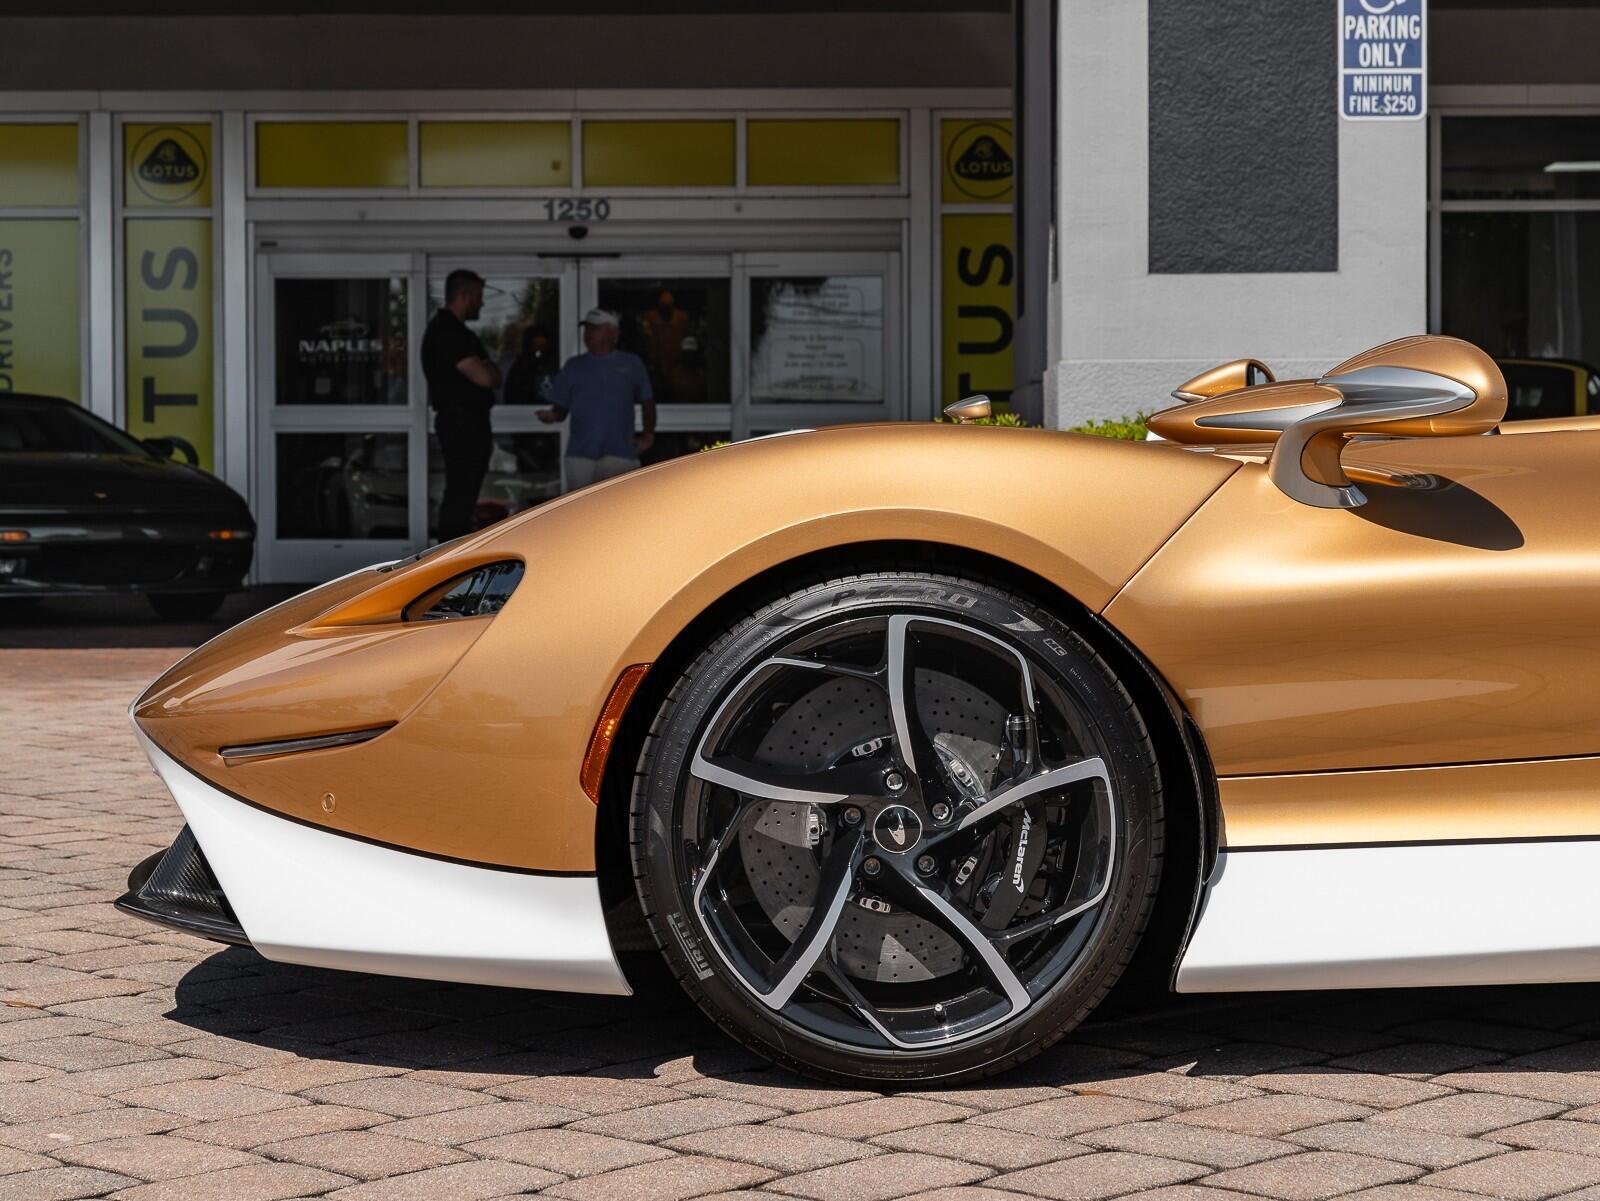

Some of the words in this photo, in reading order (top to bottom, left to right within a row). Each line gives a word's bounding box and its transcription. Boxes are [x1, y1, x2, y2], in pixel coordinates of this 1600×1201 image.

[1345, 15, 1420, 40] PARKING
[1359, 42, 1406, 67] ONLY
[1353, 75, 1412, 93] MINIMUM
[1349, 95, 1379, 113] FINE
[1383, 94, 1416, 114] $250
[143, 165, 195, 178] LOTUS
[959, 161, 1012, 175] LOTUS
[543, 199, 611, 221] 1250
[299, 339, 383, 353] NAPLES
[831, 588, 857, 607] P
[869, 585, 978, 609] ZERO
[1013, 809, 1032, 885] McLaren
[666, 912, 715, 980] PIRELLI
